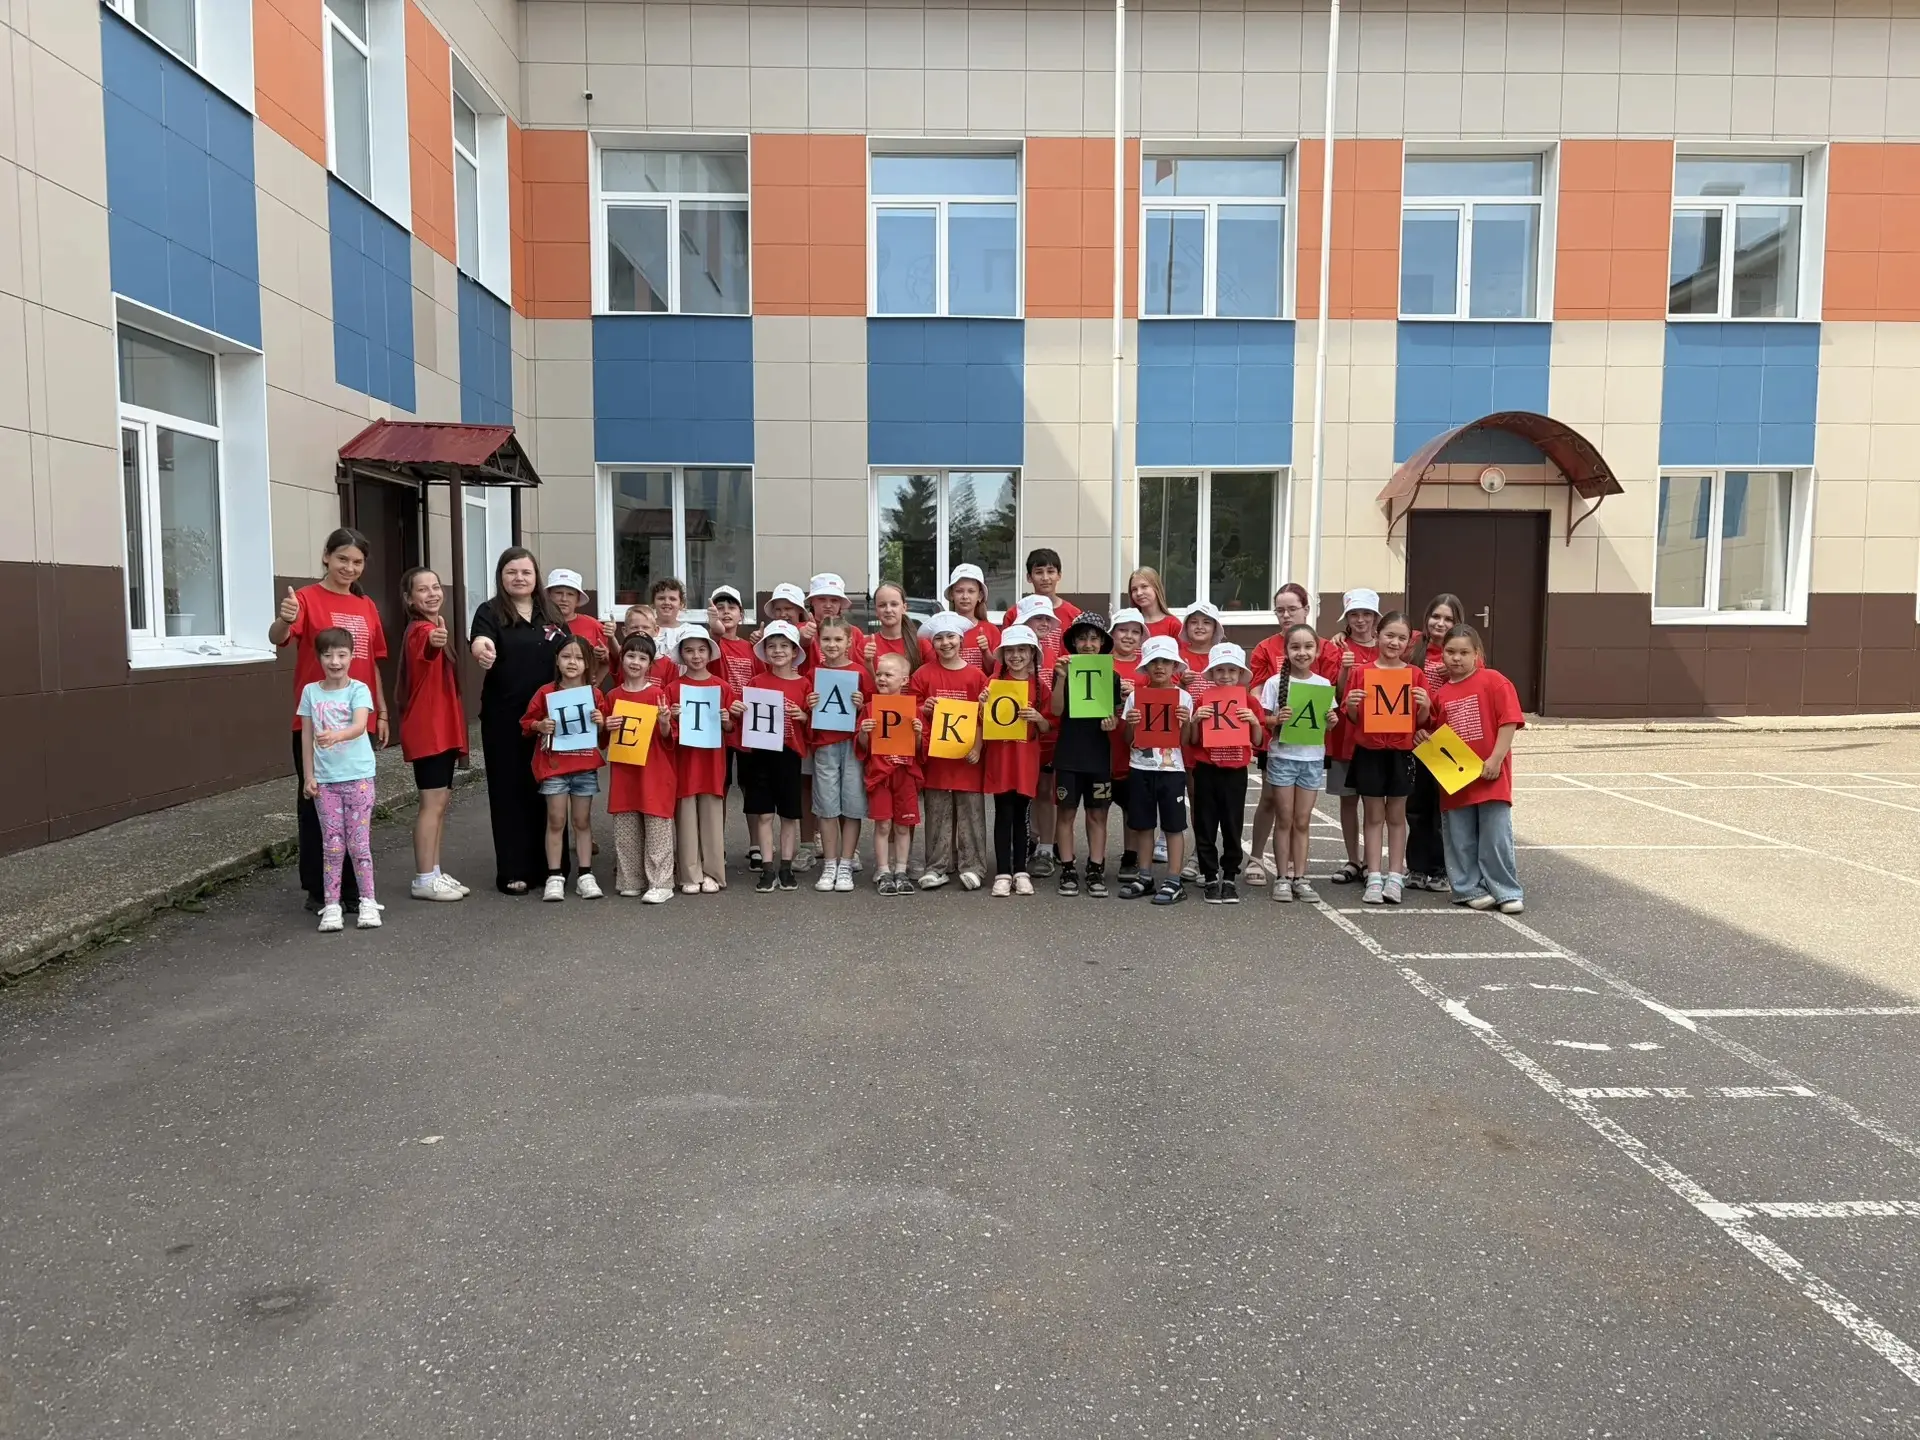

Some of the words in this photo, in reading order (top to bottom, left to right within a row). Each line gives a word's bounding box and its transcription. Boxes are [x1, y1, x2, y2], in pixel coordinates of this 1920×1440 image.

[555, 703, 590, 736] Н
[614, 716, 642, 746] Е
[686, 700, 711, 731] Т
[749, 702, 777, 734] Н
[819, 684, 850, 715] А
[878, 710, 902, 739] Р
[938, 712, 968, 744] К
[991, 696, 1020, 726] О
[1075, 669, 1102, 700] Т
[1142, 702, 1173, 732] И
[1211, 699, 1240, 730] К
[1289, 699, 1320, 729] А
[1372, 683, 1411, 715] М
